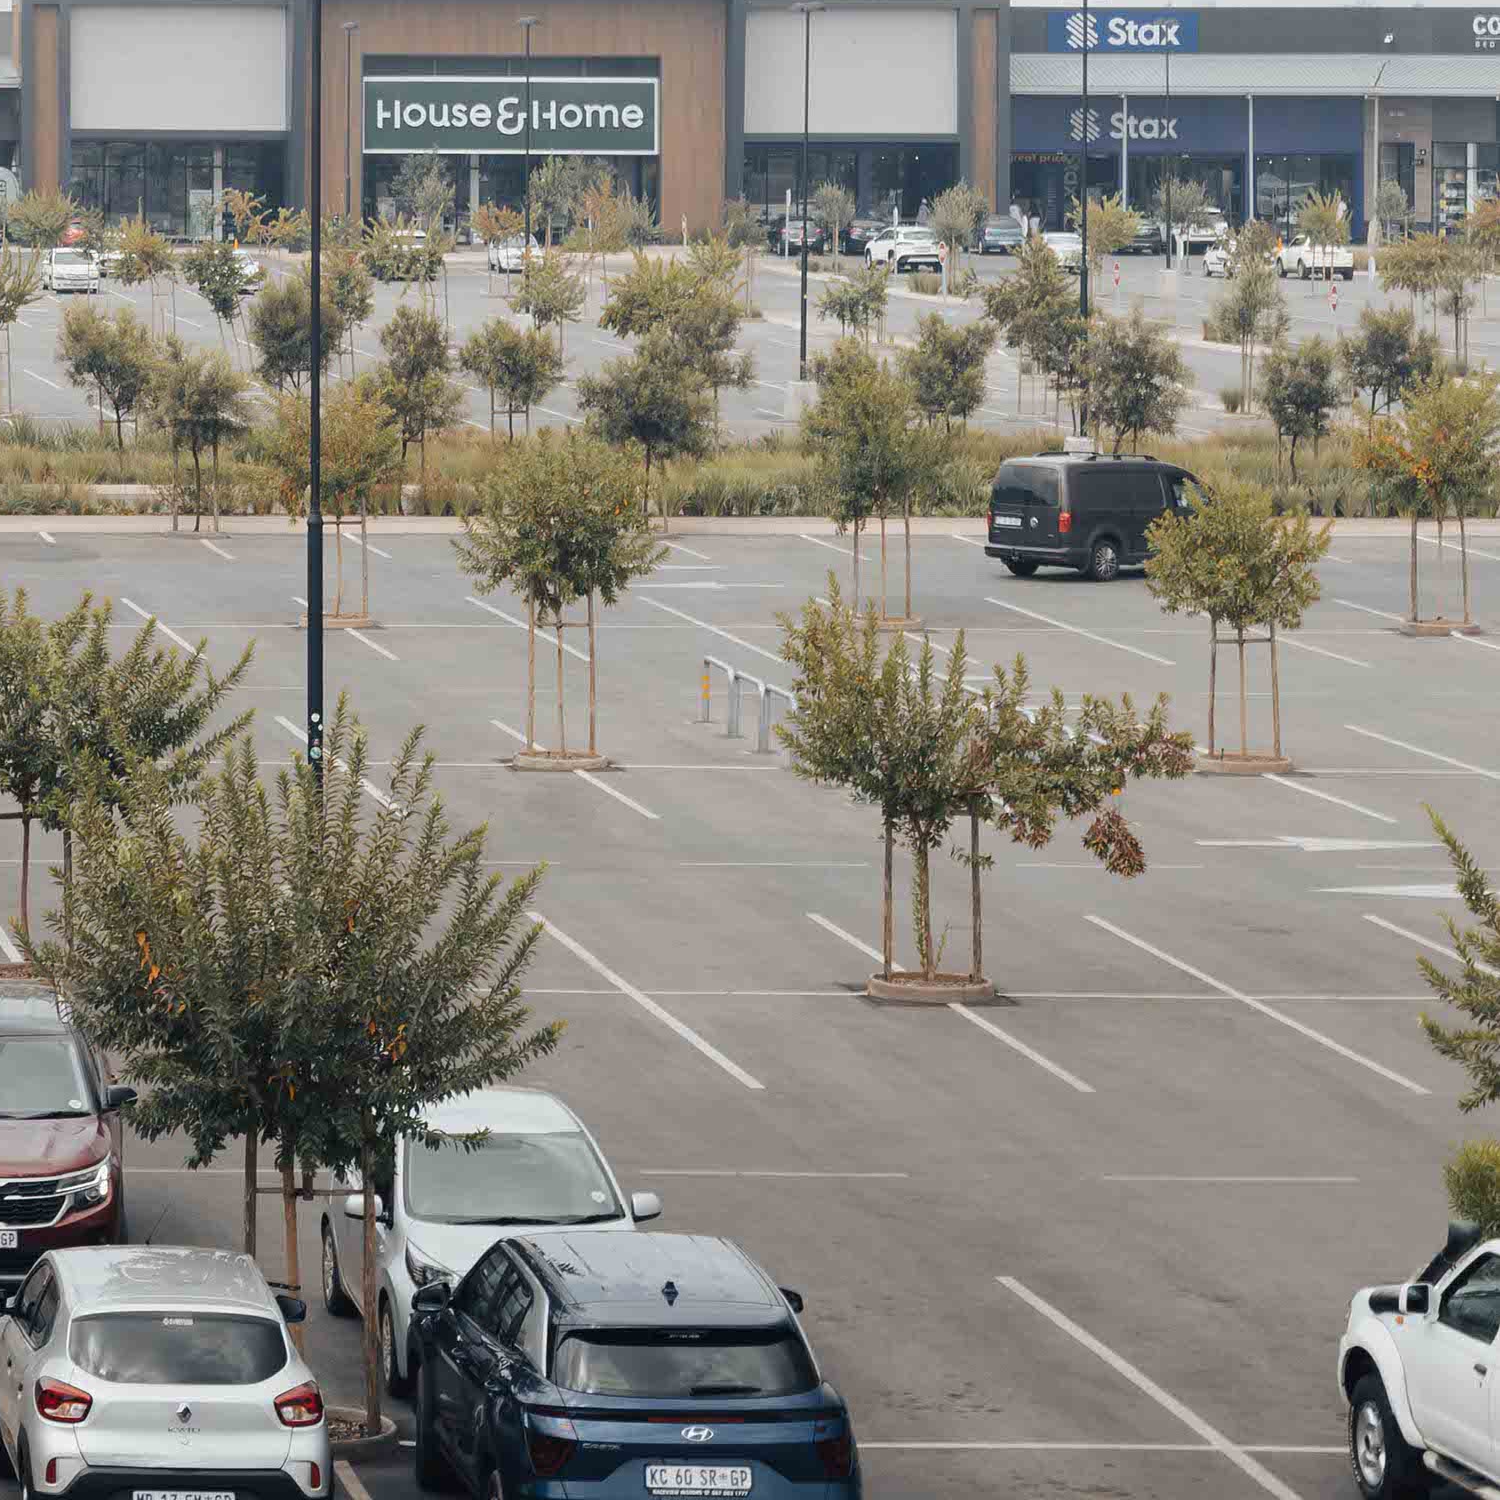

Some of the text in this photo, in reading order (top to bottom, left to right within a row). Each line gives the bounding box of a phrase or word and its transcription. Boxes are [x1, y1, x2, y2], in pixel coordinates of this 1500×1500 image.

[1108, 16, 1180, 48] Stax
[376, 98, 491, 130] House
[533, 98, 644, 130] Home
[1109, 112, 1178, 140] Stax
[1, 1233, 15, 1246] GP
[650, 1468, 748, 1486] KC 60 SR GP
